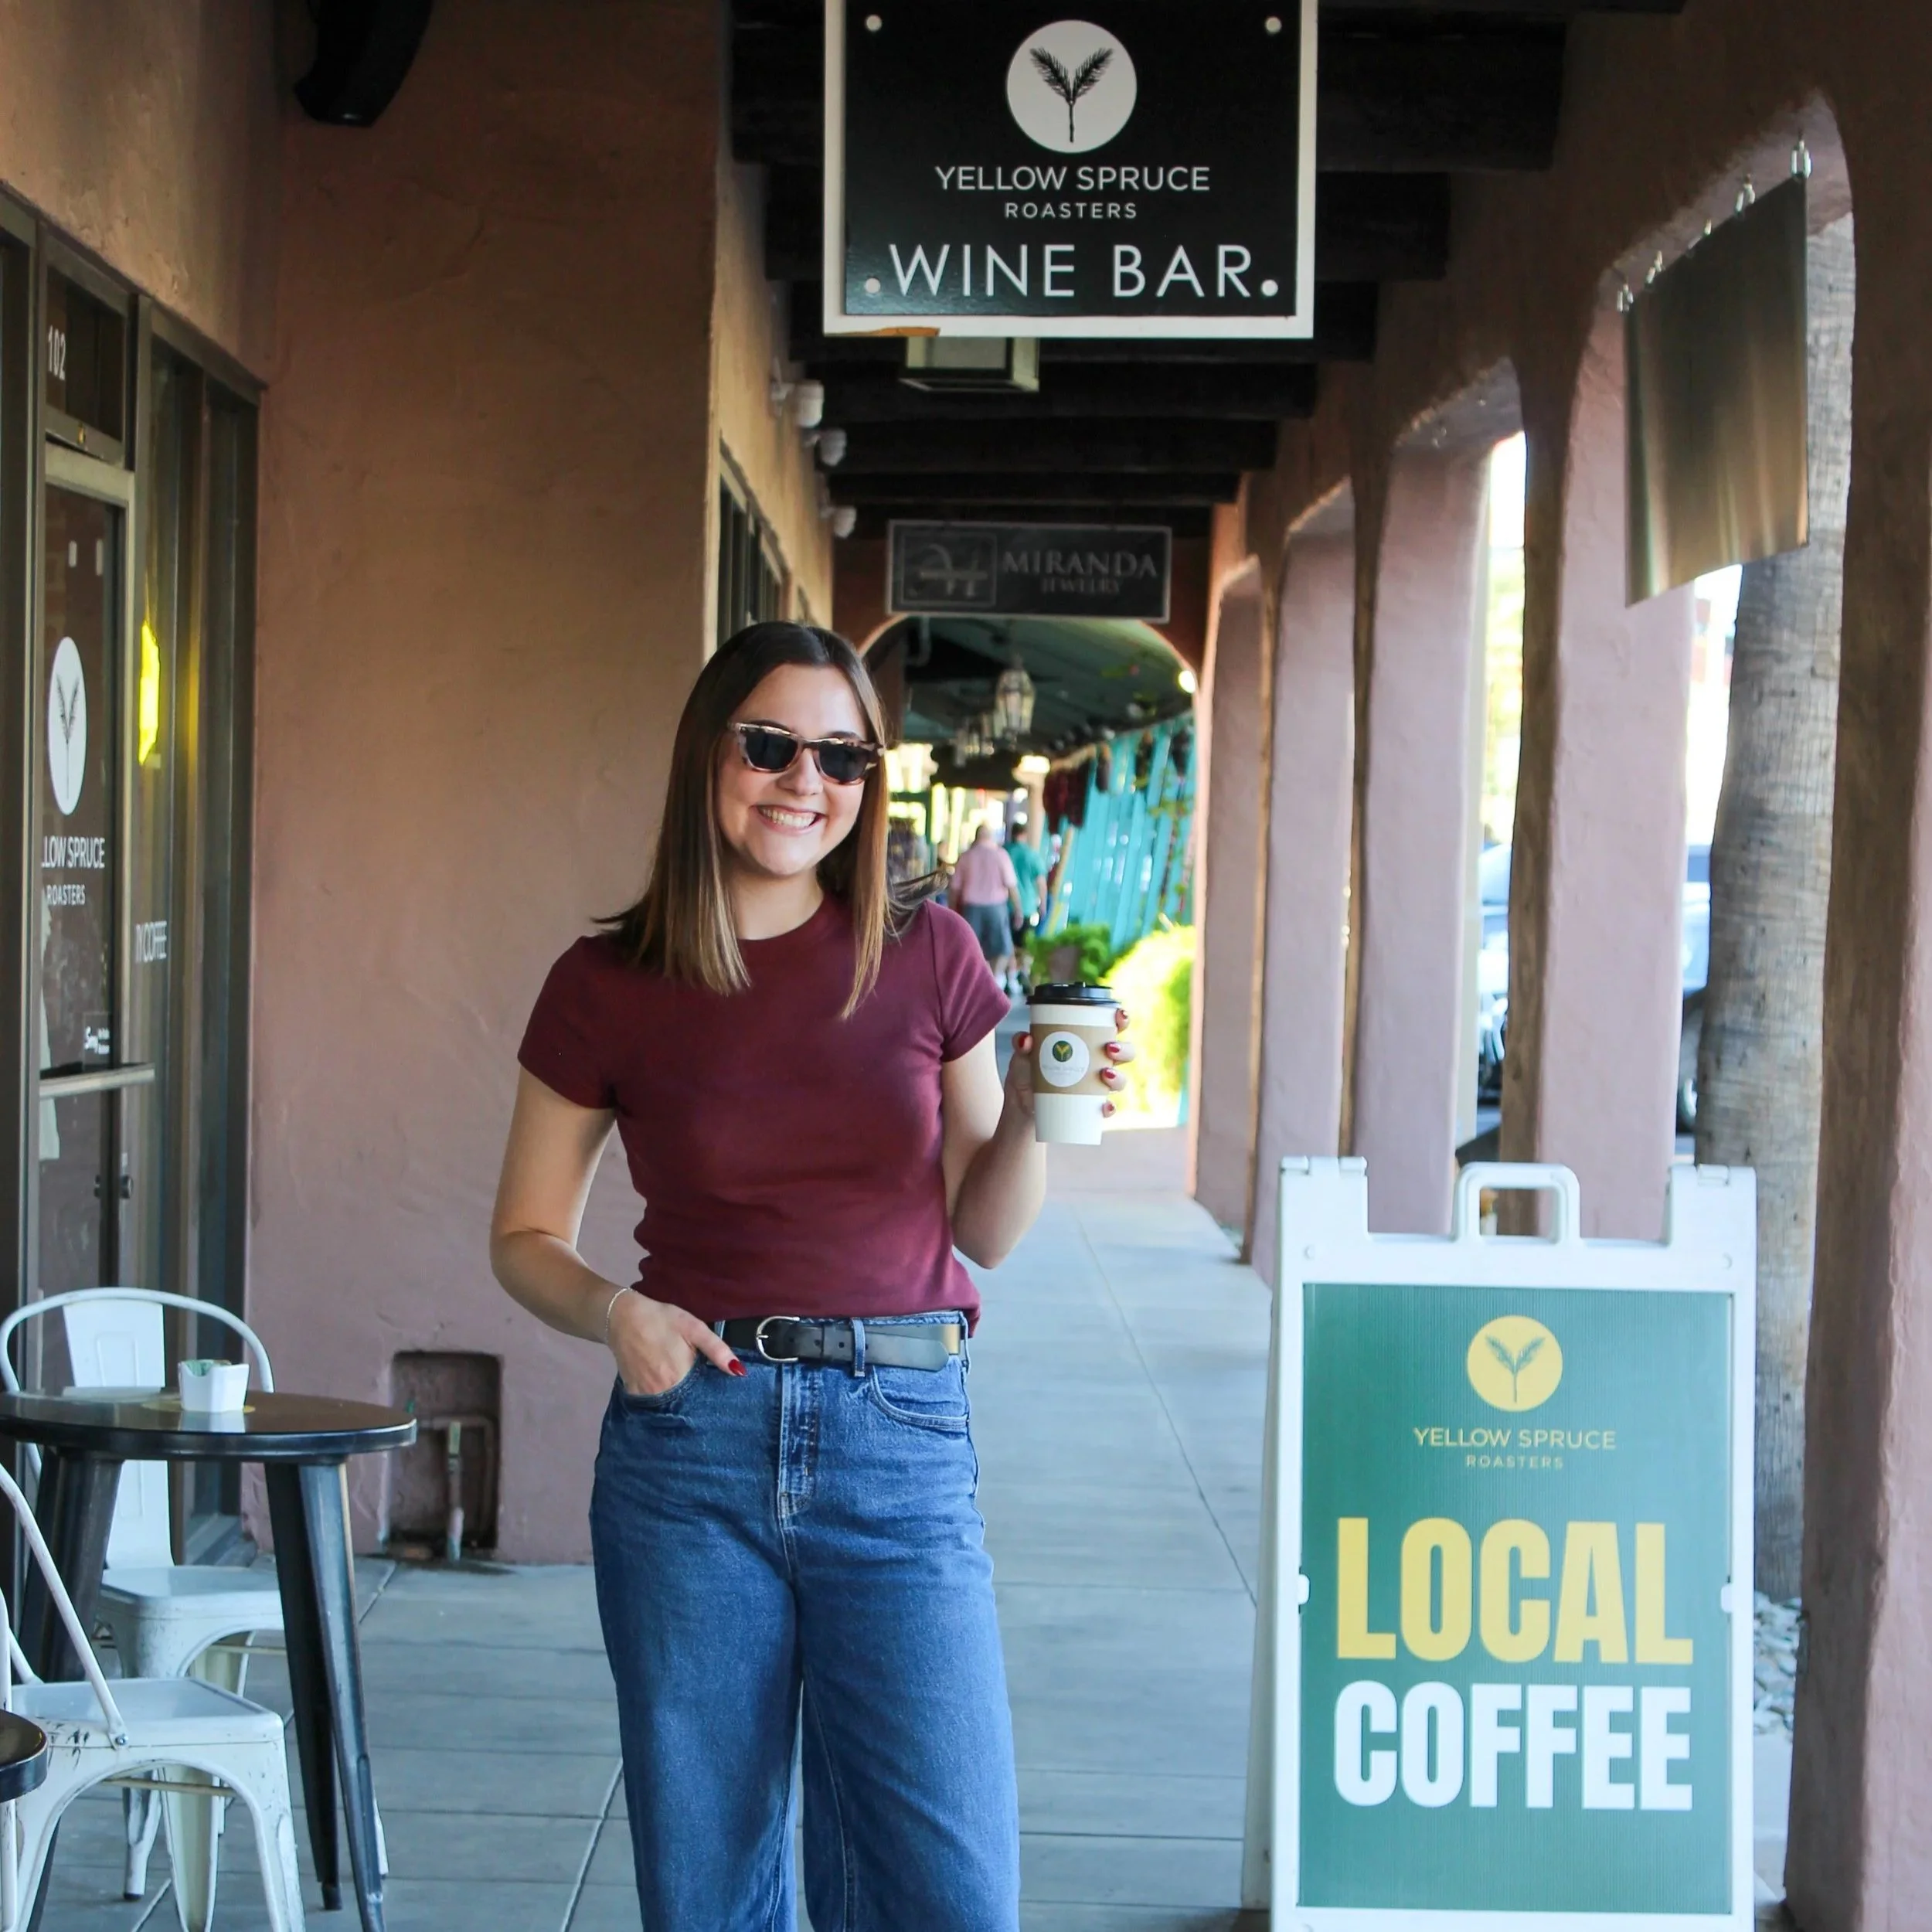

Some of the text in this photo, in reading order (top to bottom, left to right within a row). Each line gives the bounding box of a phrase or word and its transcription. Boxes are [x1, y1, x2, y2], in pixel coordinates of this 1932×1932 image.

[935, 166, 1210, 192] YELLOW SPRUCE
[1005, 202, 1138, 219] ROASTERS
[889, 243, 1251, 298] WINE BAR
[48, 325, 66, 380] 102
[1004, 549, 1157, 578] MIRANDA
[41, 835, 105, 869] LOW SPRUCE
[46, 883, 86, 906] ROASTERS
[1413, 1427, 1617, 1451] YELLOW SPRUCE
[1465, 1454, 1565, 1471] ROASTERS
[1337, 1517, 1694, 1666] LOCAL
[1334, 1679, 1693, 1811] COFFEE
